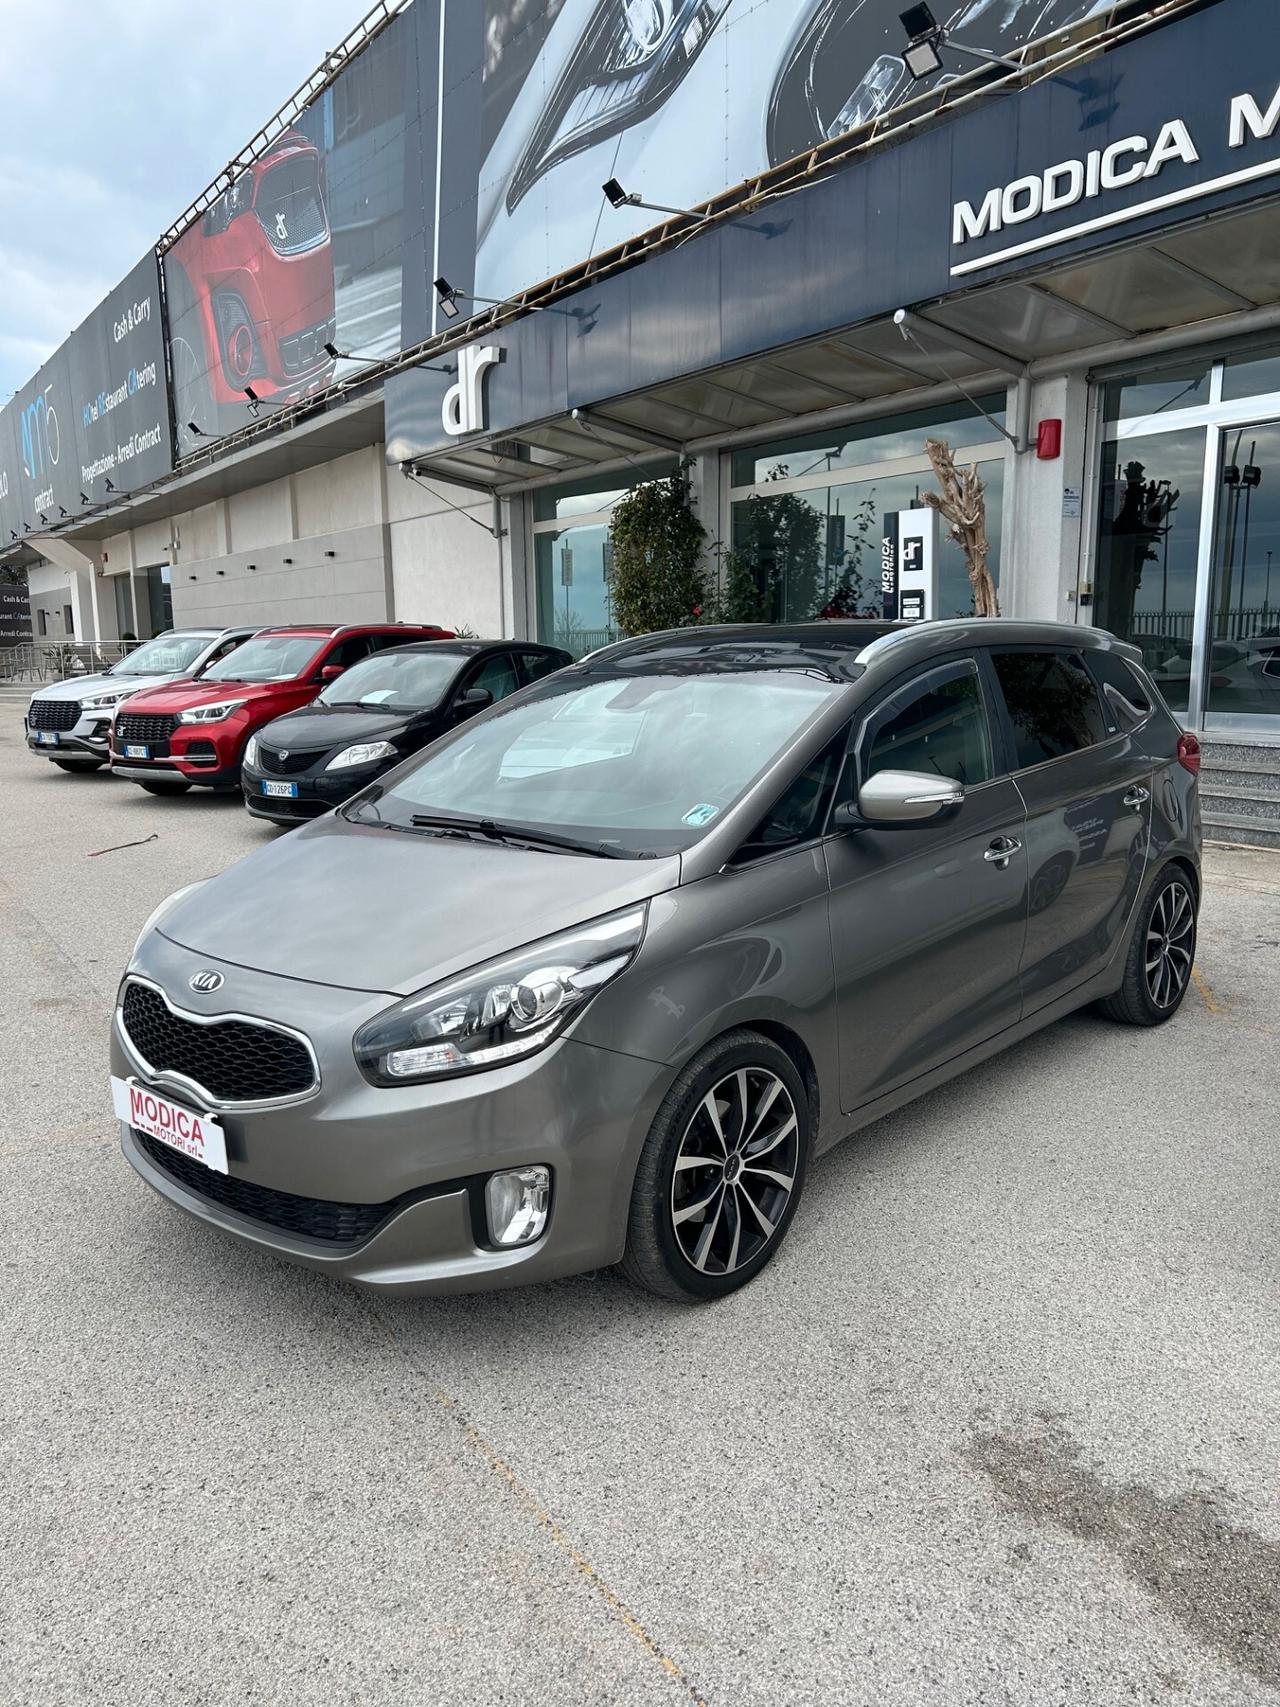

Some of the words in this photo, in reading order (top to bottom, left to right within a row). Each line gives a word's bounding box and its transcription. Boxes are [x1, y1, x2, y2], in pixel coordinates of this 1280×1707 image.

[952, 118, 1199, 244] MODICA
[114, 315, 129, 343] Cash
[128, 311, 135, 331] &
[134, 296, 151, 325] Carry
[83, 401, 98, 428] HOtel
[98, 383, 128, 417] REstaurant
[128, 361, 156, 396] CAtering
[442, 345, 499, 436] dr
[81, 453, 116, 483] Progettazione
[117, 436, 135, 464] Arredi
[134, 423, 161, 453] Contract
[34, 486, 54, 513] contract
[882, 537, 891, 593] MODICA
[904, 542, 921, 560] dr
[3, 595, 15, 603] Cash
[193, 974, 217, 989] KIA
[129, 1088, 205, 1147] MODICA
[153, 1125, 186, 1150] MOTORI
[187, 1144, 199, 1158] srl
